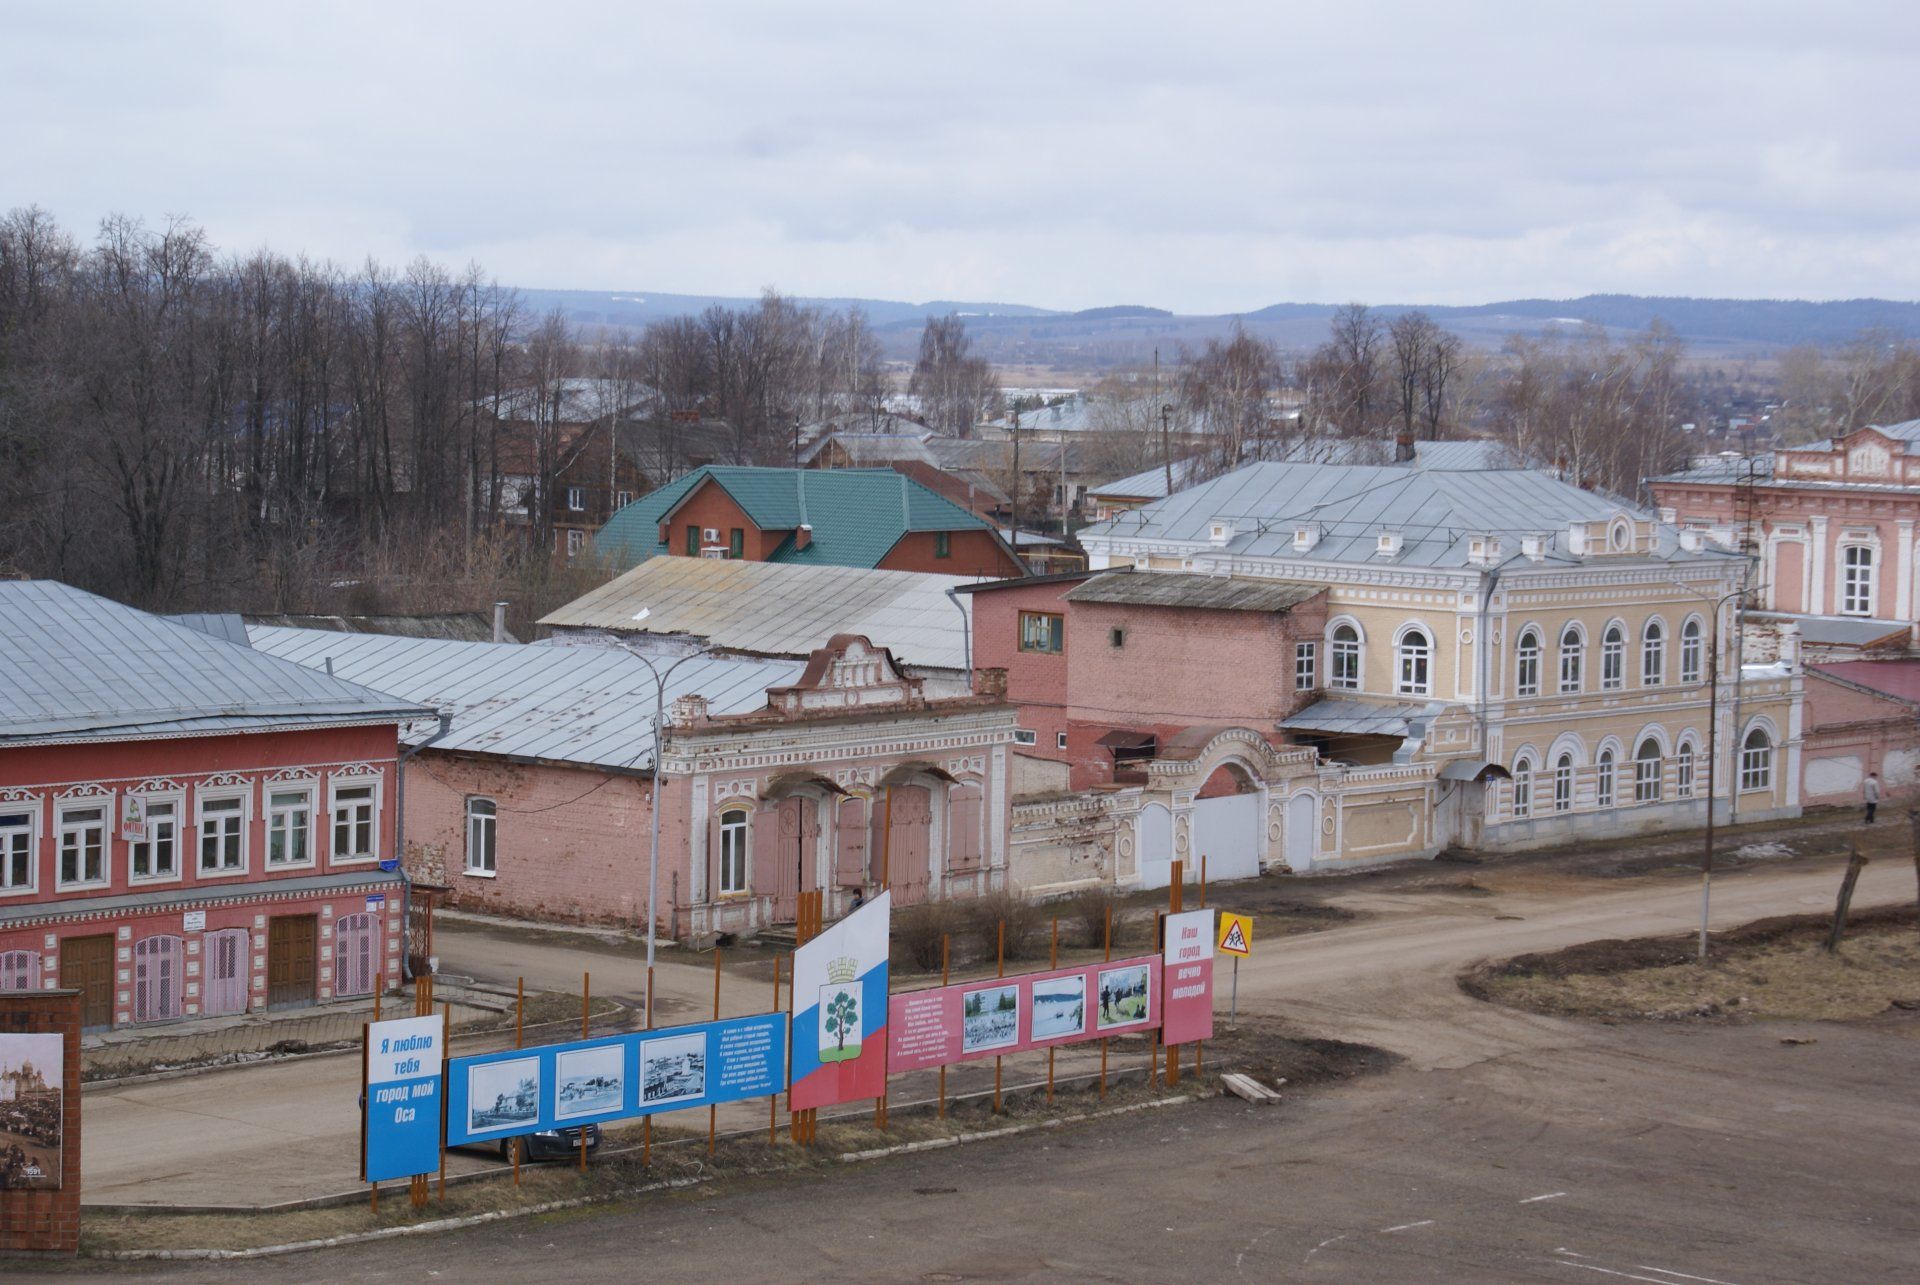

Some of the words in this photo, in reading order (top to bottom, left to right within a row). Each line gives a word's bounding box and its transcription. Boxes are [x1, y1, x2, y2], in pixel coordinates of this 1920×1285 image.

[1181, 927, 1198, 940] Наш
[1179, 945, 1201, 959] город
[1177, 965, 1202, 980] вечно
[1172, 981, 1206, 1000] молодой
[381, 1038, 389, 1054] Я
[393, 1034, 433, 1053] люблю
[394, 1058, 420, 1075] тебя
[376, 1085, 410, 1104] город
[411, 1080, 435, 1098] мой
[394, 1106, 416, 1124] Оса
